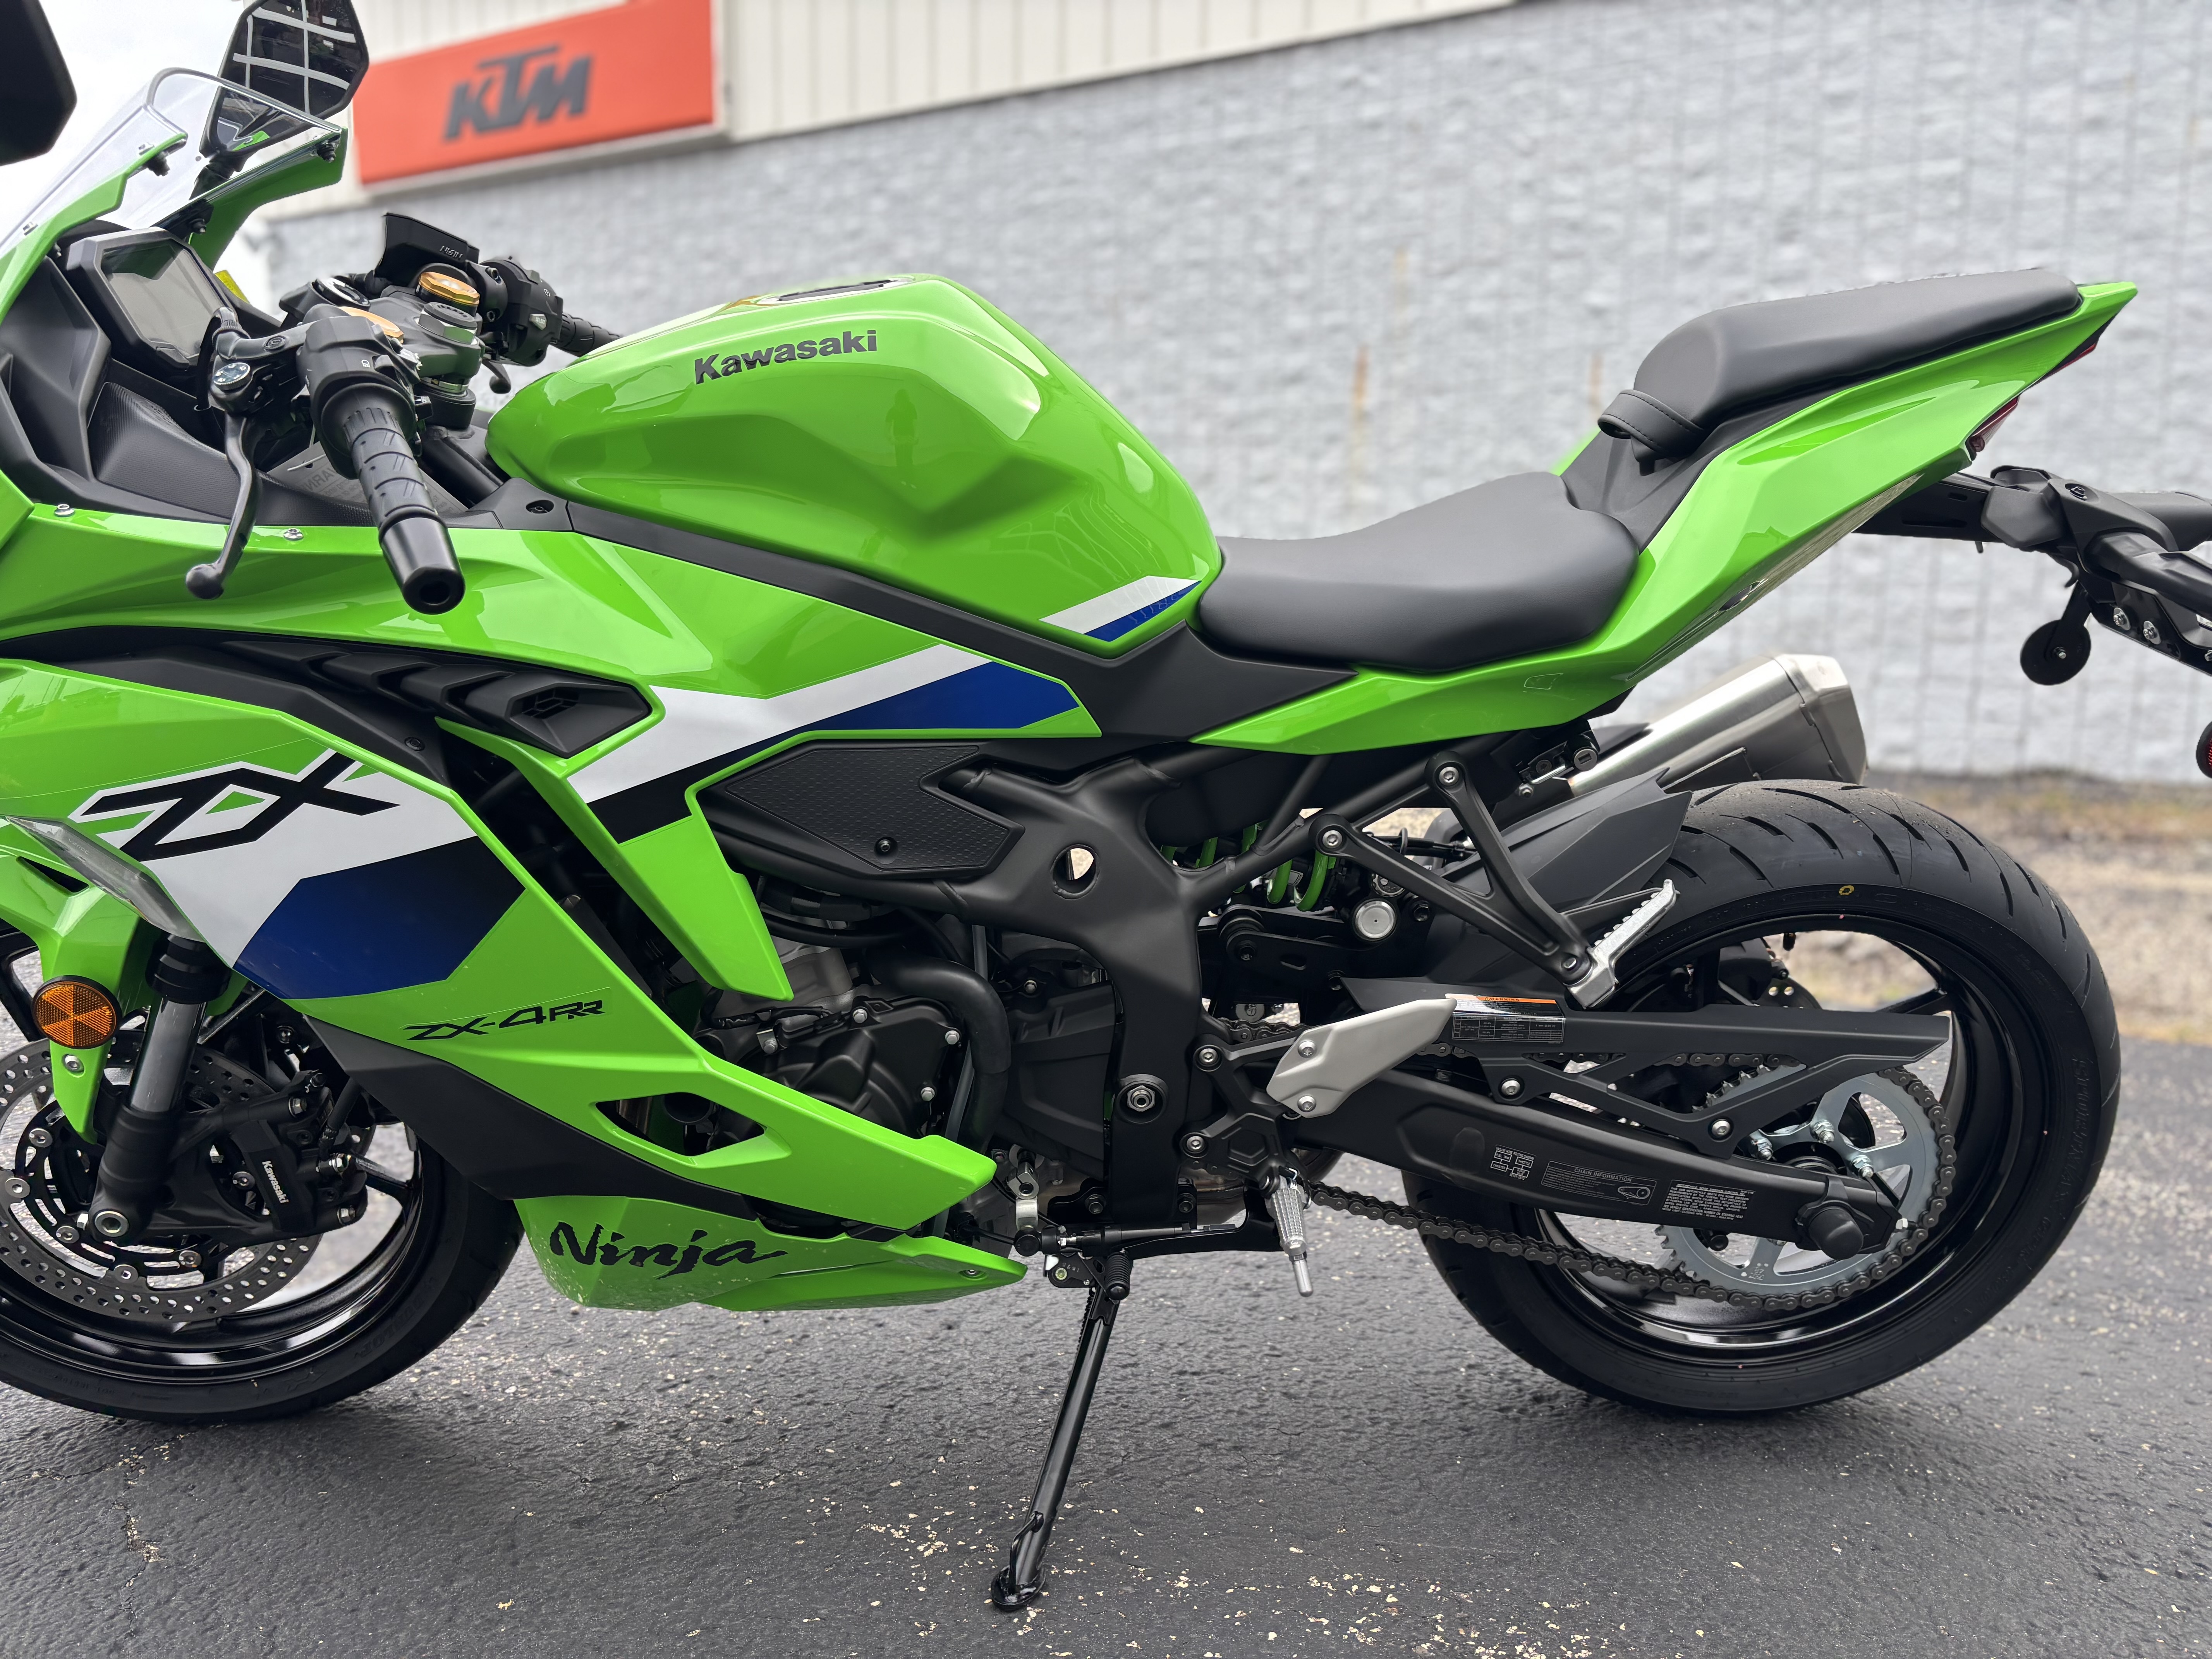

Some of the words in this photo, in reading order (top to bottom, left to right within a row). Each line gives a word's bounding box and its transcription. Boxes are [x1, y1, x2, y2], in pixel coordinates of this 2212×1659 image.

[443, 45, 592, 141] KTM
[694, 330, 877, 384] Kawasaki
[81, 750, 401, 862] ZX
[403, 1000, 605, 1041] ZX-4RR
[262, 1161, 289, 1203] Kawasaki
[1593, 1172, 1632, 1182] INFORMATION
[550, 1222, 789, 1279] Ninja
